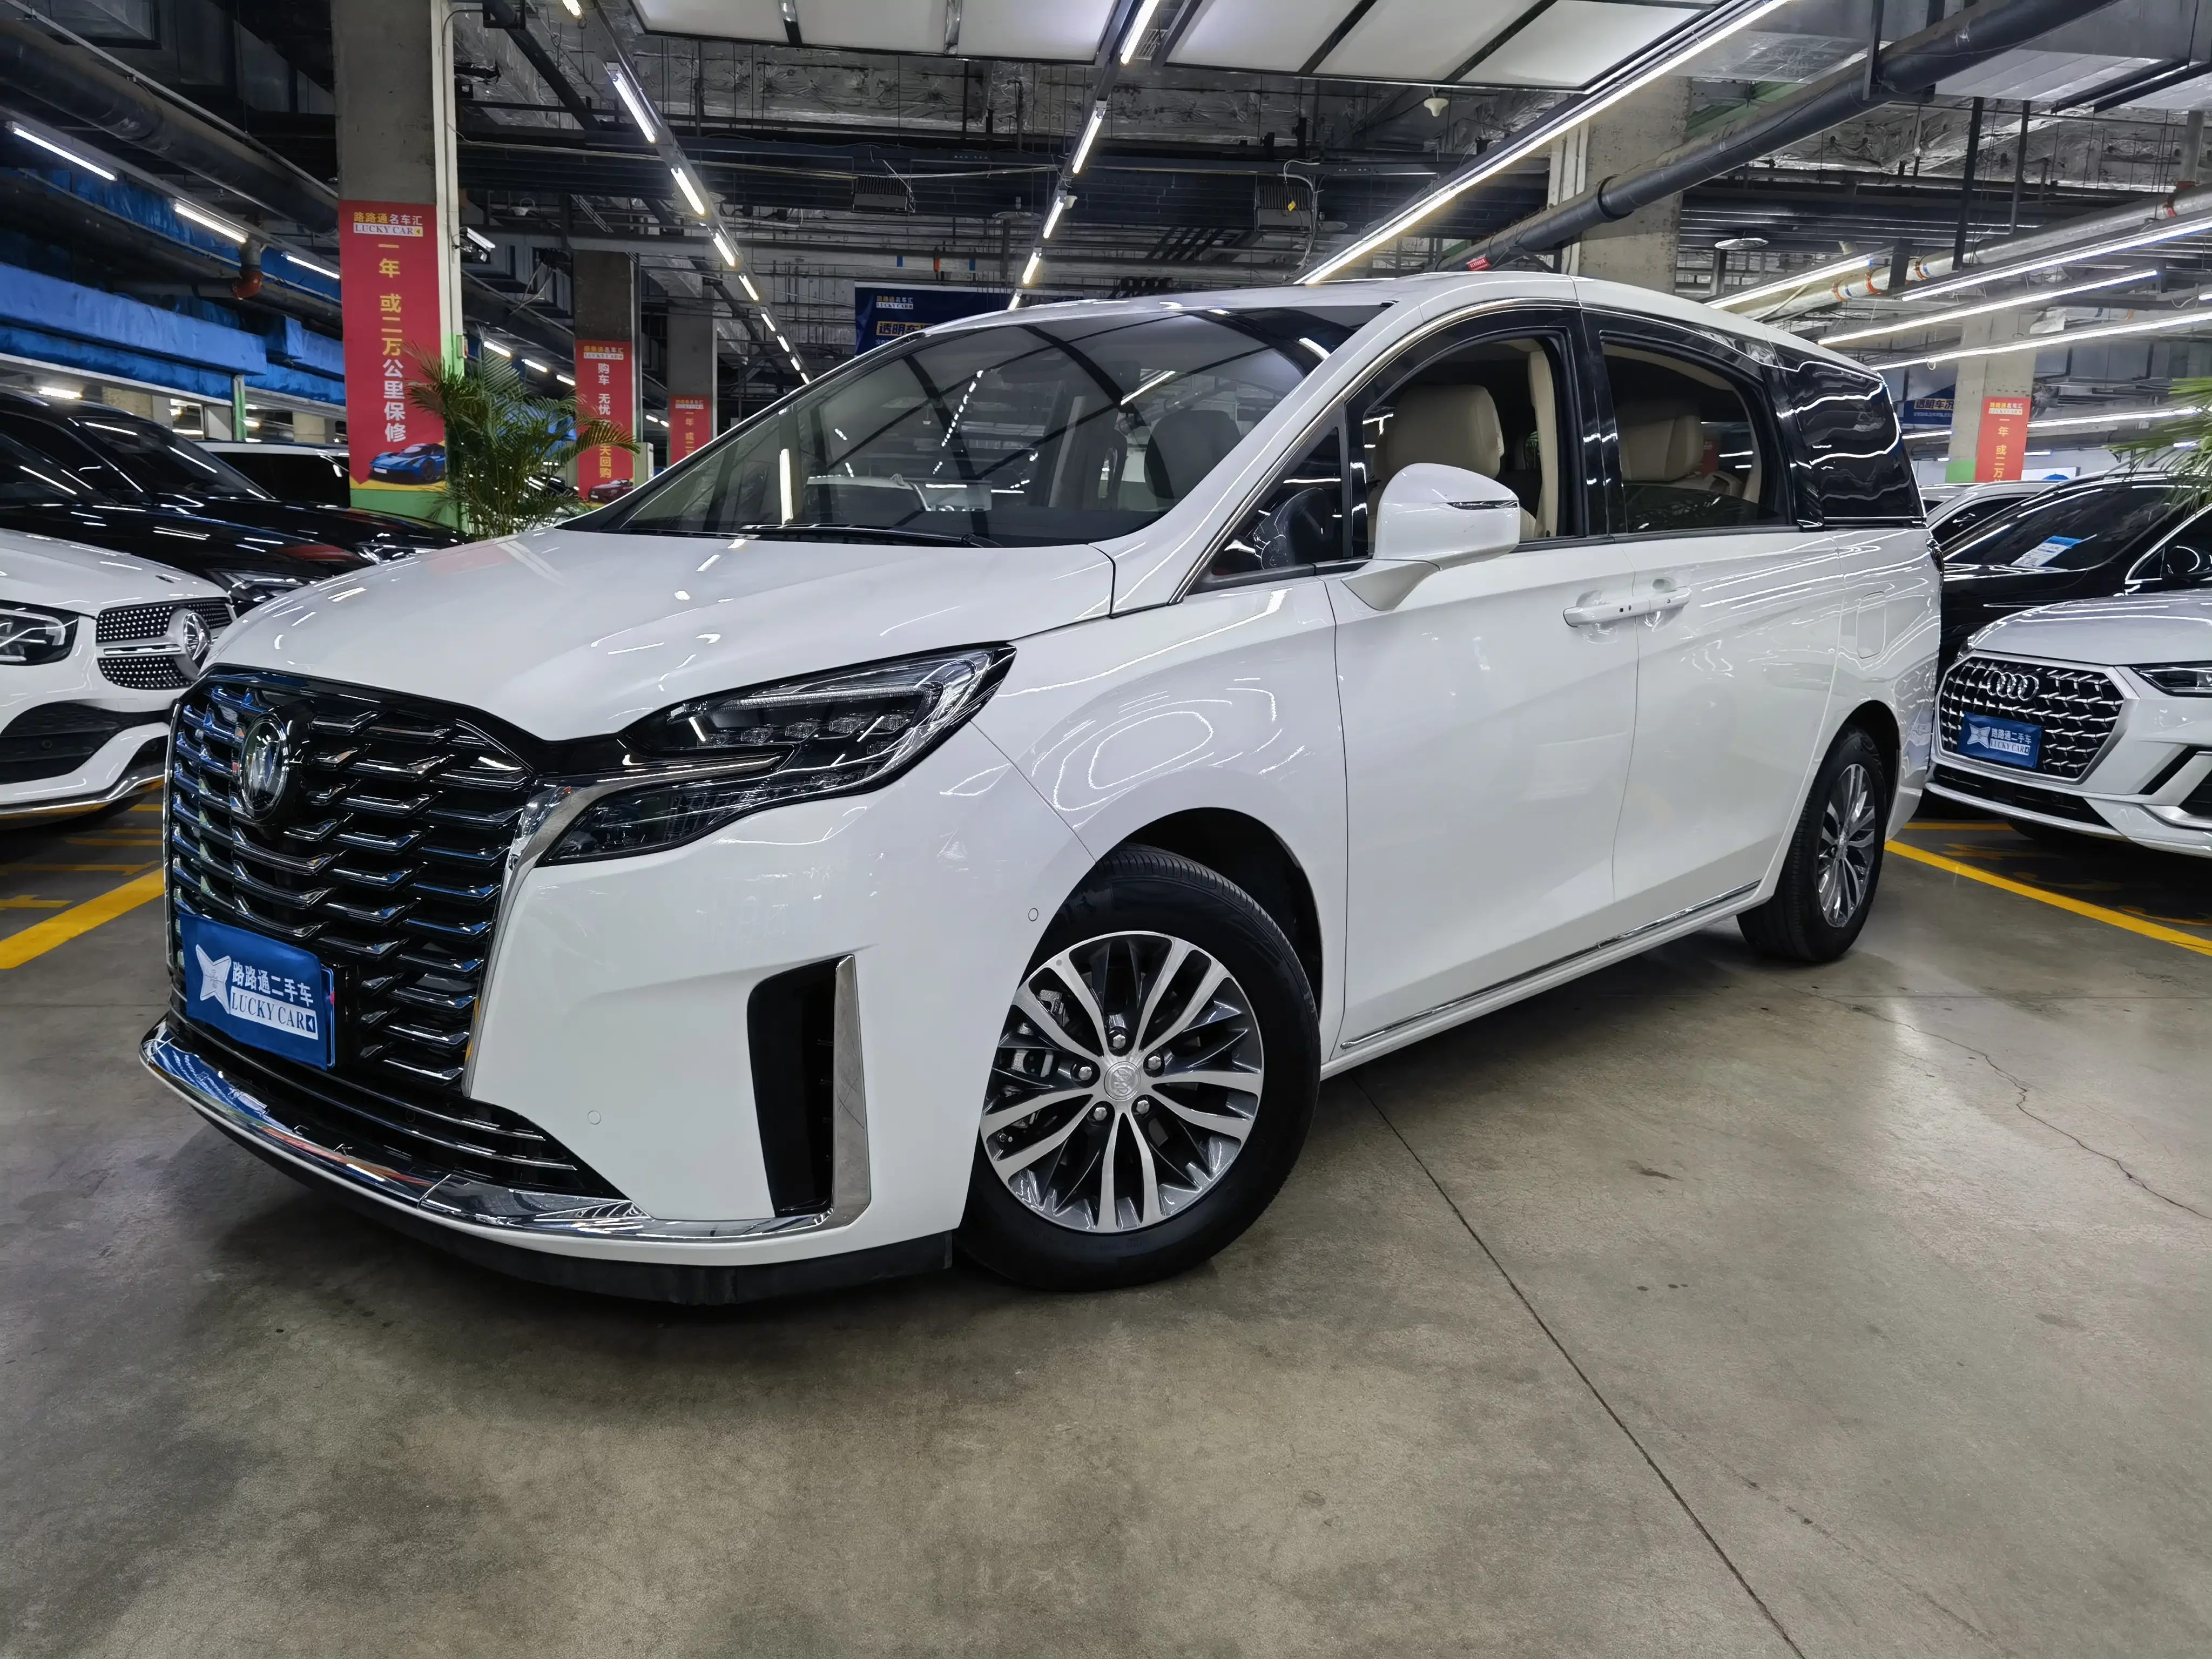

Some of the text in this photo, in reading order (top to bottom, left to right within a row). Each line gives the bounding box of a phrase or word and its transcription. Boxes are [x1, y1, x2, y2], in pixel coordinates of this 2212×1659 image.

[354, 212, 422, 226] 路路通名车汇
[355, 224, 414, 235] LUCKY CAR
[879, 323, 925, 335] 透明车
[1993, 444, 2007, 482] 或二万
[1991, 728, 2032, 744] 路路通二手车
[1991, 739, 2025, 753] LUCKY CAR
[232, 961, 314, 1007] 路路通二手车
[232, 992, 305, 1030] LUCKY CAR
